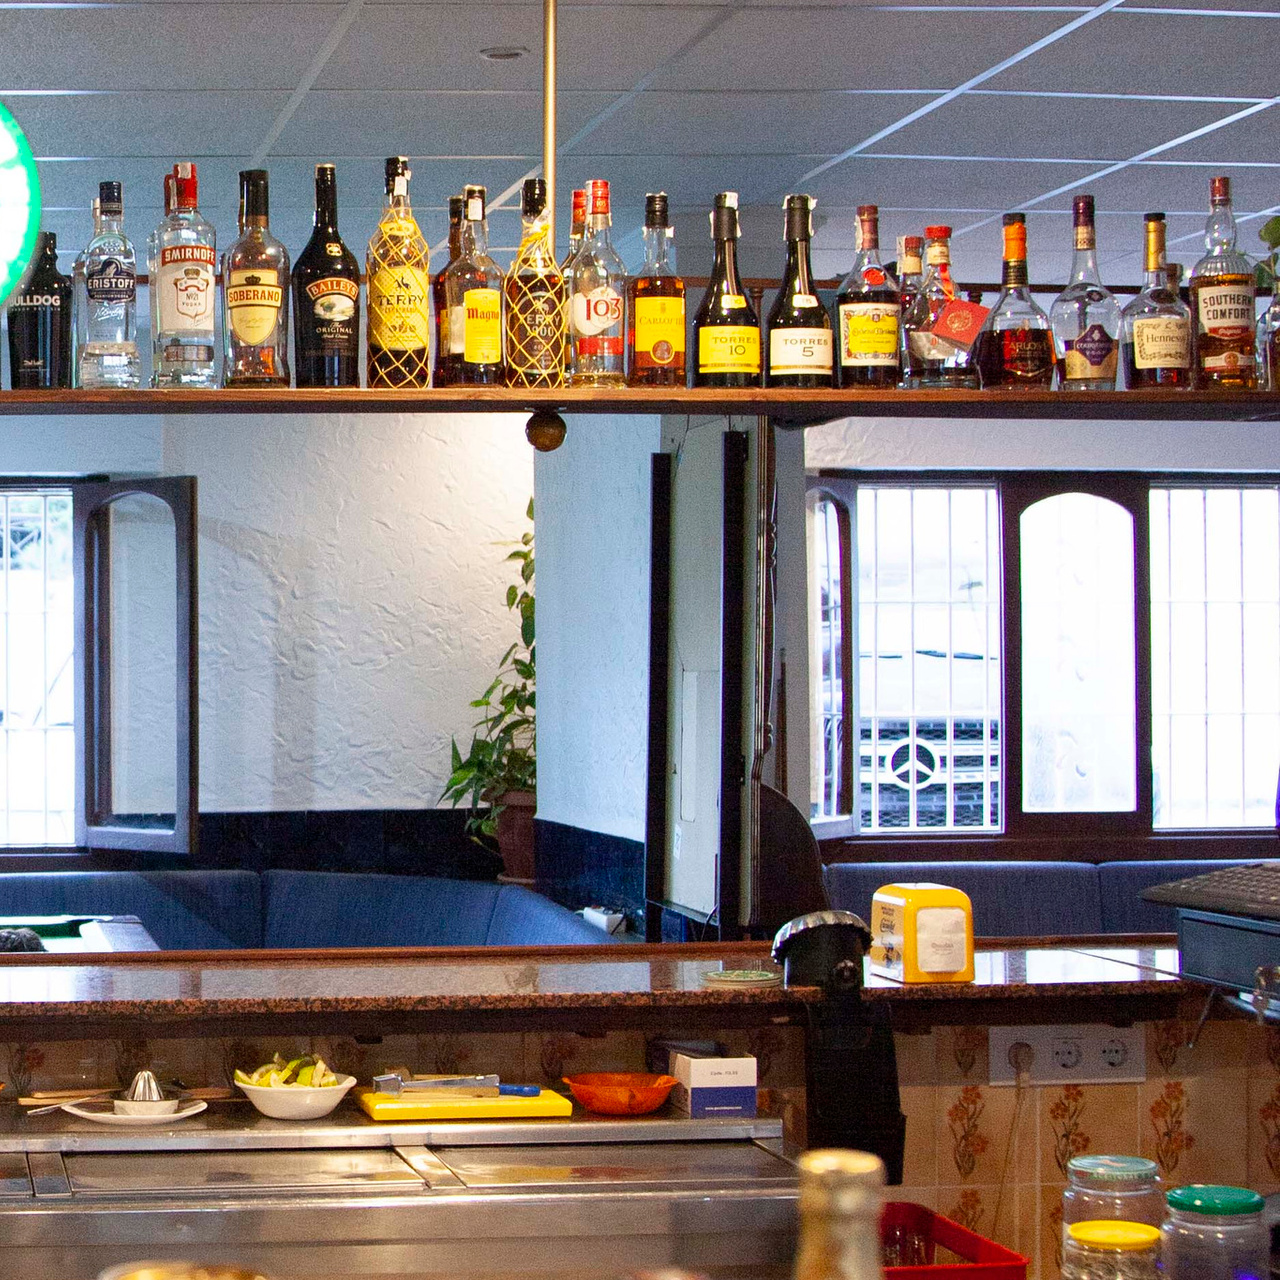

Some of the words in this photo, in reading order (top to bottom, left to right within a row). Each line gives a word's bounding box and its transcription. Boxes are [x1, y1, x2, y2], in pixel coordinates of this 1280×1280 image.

[164, 247, 215, 264] SMIRNOFF
[87, 279, 135, 290] ERISTOFF
[311, 279, 357, 295] BAILEYS
[228, 291, 280, 303] SOBERANO
[377, 295, 424, 306] TERRY
[1202, 294, 1252, 308] SOUTHERN
[586, 298, 621, 321] 103
[1206, 308, 1251, 320] COMFORT
[526, 315, 561, 324] ERRY
[783, 338, 828, 346] TORRES
[1146, 333, 1187, 344] Hennes
[729, 345, 746, 355] 10
[802, 347, 814, 357] 5
